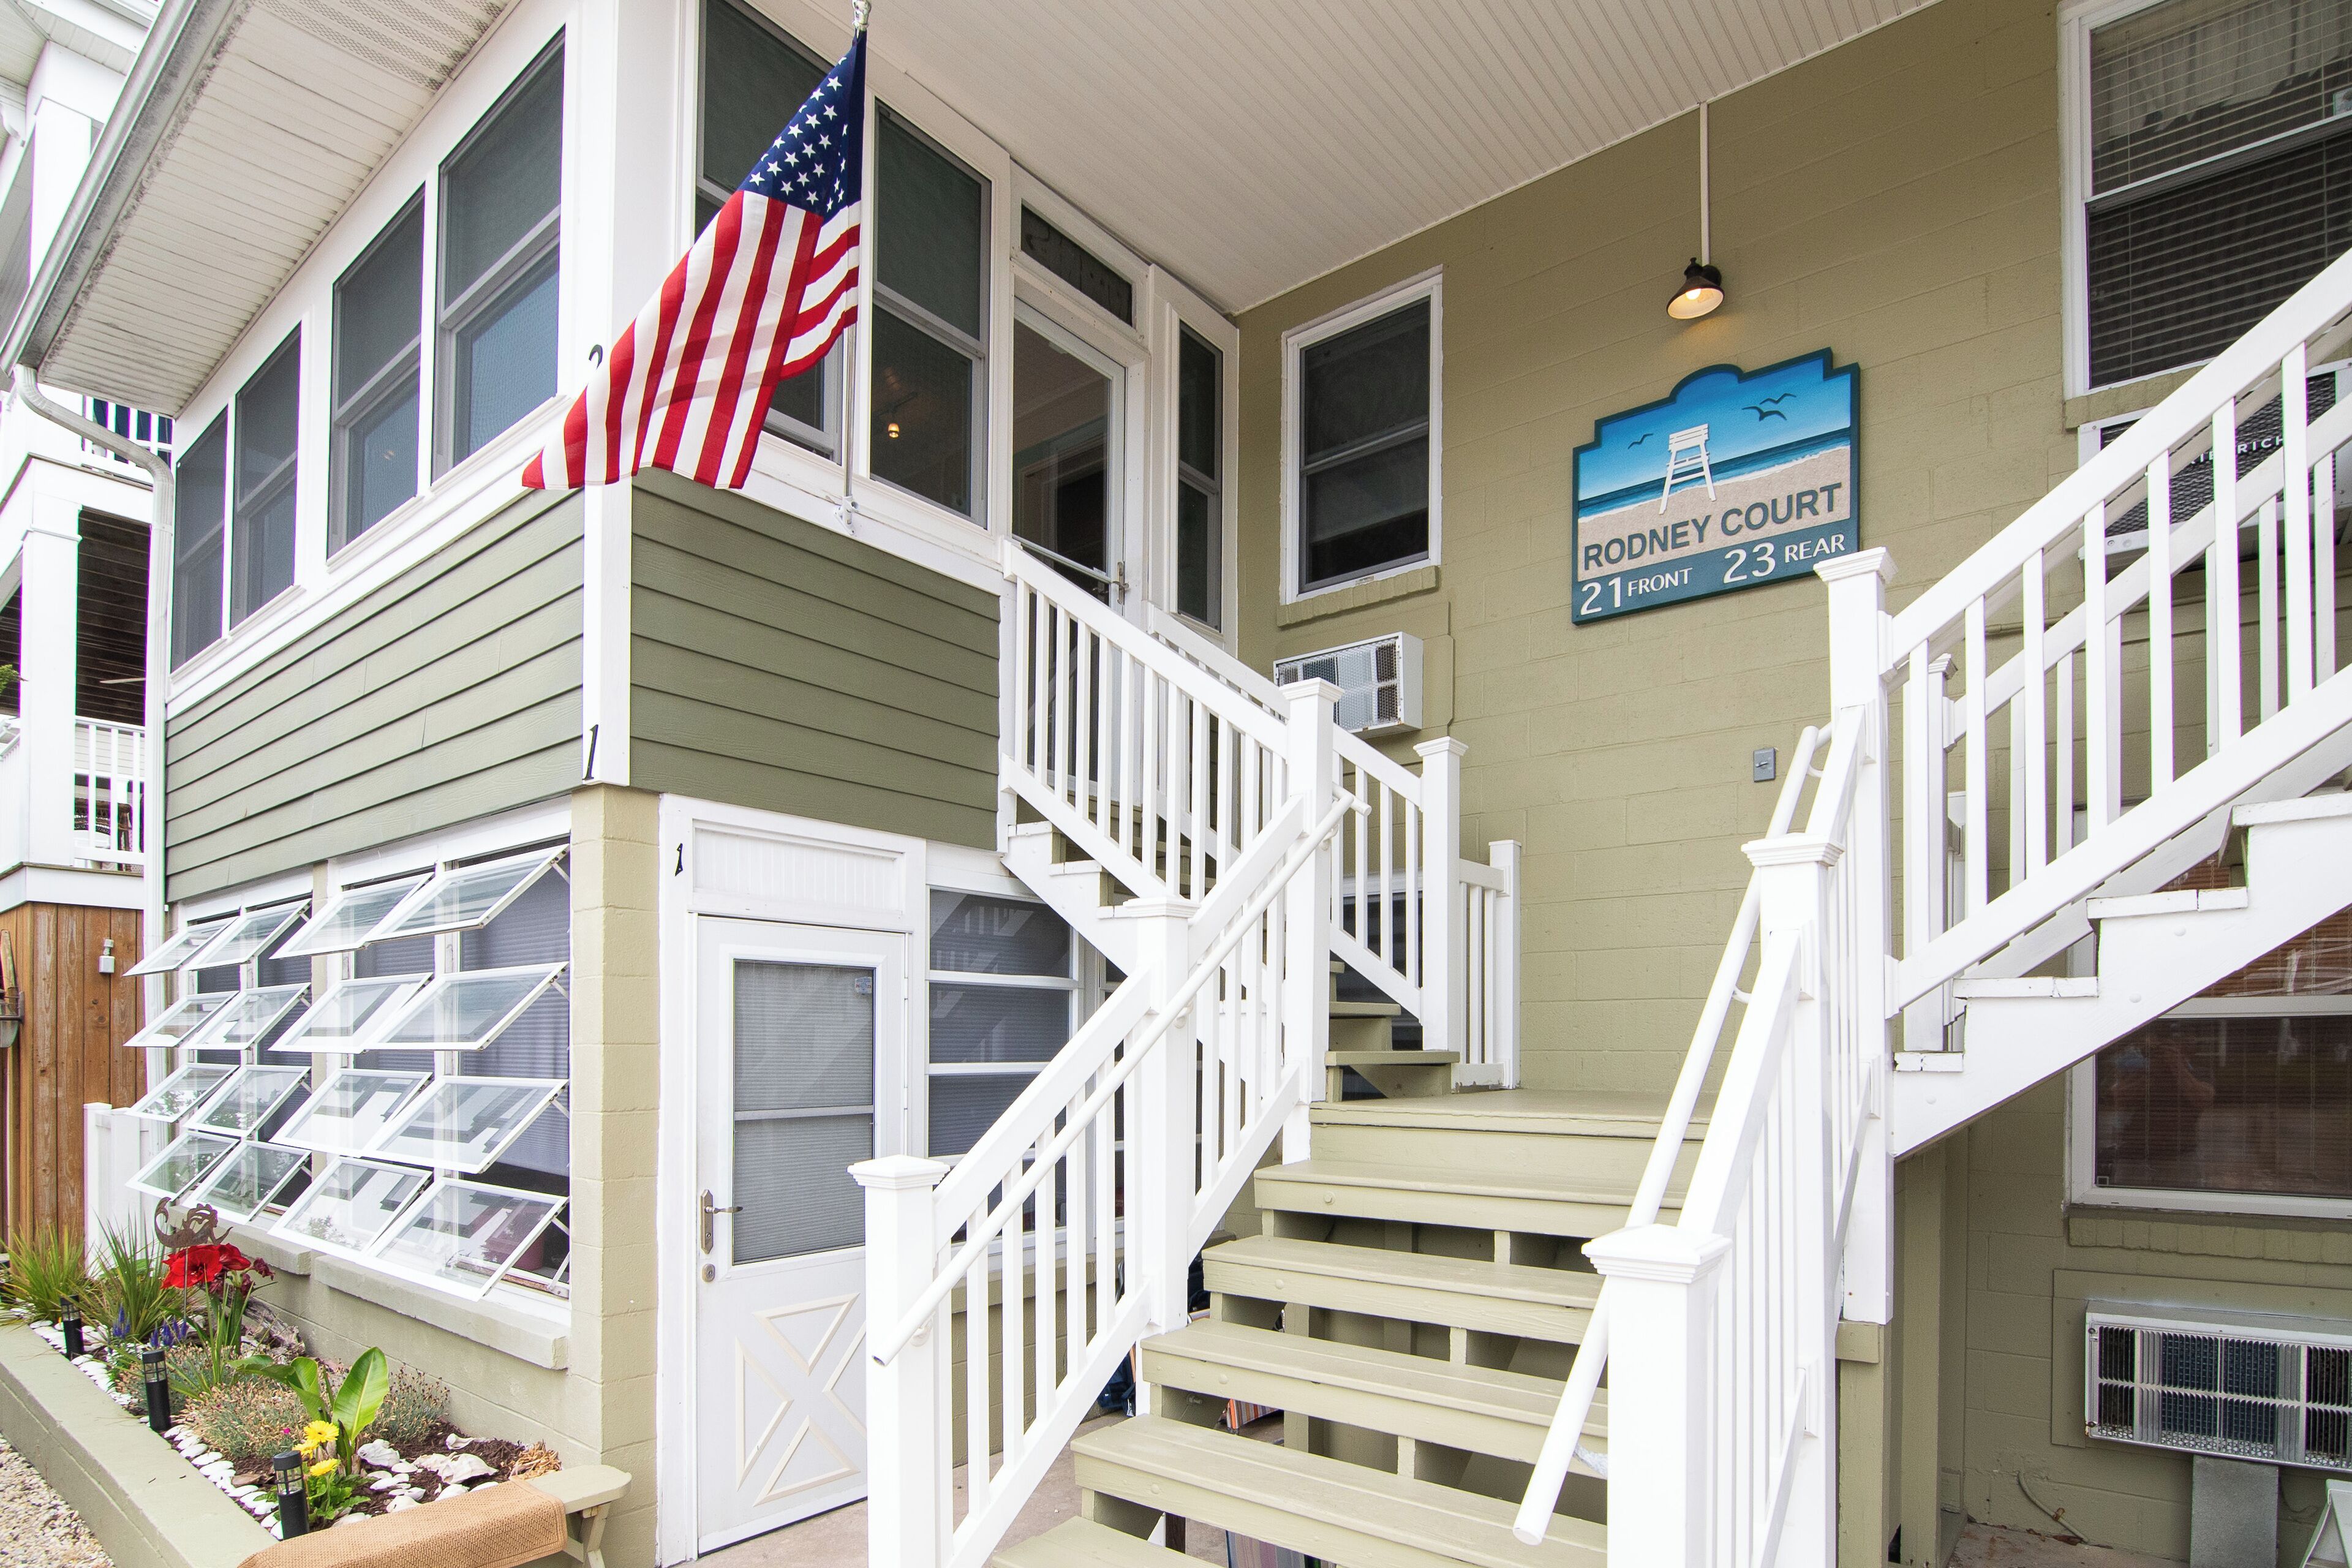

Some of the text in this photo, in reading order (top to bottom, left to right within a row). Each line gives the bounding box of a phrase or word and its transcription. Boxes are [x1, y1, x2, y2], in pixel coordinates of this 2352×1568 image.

[2190, 435, 2283, 464] IERICH
[1584, 482, 1842, 570] RODNEY COURT
[1580, 533, 1845, 616] 21 FRONT 23 REAR
[582, 724, 599, 780] 1
[675, 843, 684, 876] 1
